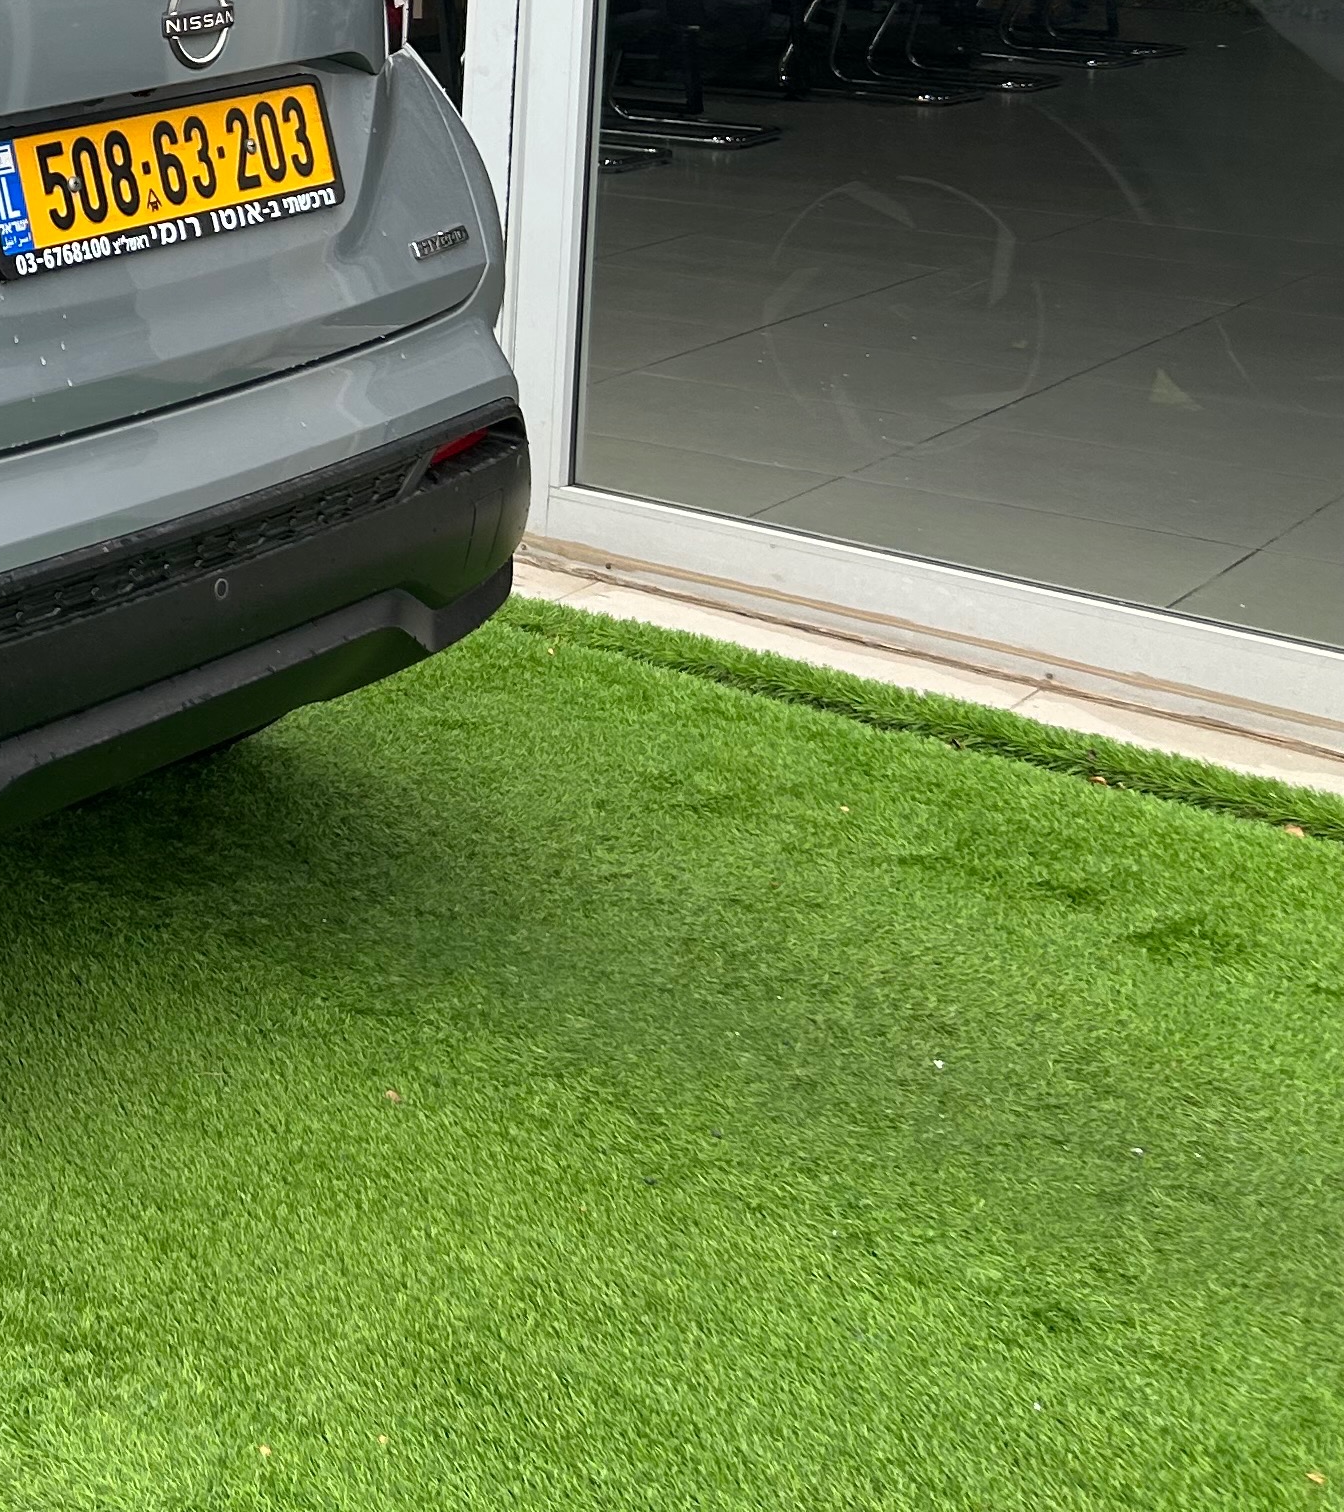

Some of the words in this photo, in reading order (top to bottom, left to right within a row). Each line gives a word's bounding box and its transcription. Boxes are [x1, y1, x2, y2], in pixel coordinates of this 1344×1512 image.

[165, 9, 233, 34] NISSAN
[282, 187, 336, 215] נרכשתי
[148, 216, 203, 246] רומי
[15, 235, 111, 275] 03-6768100
